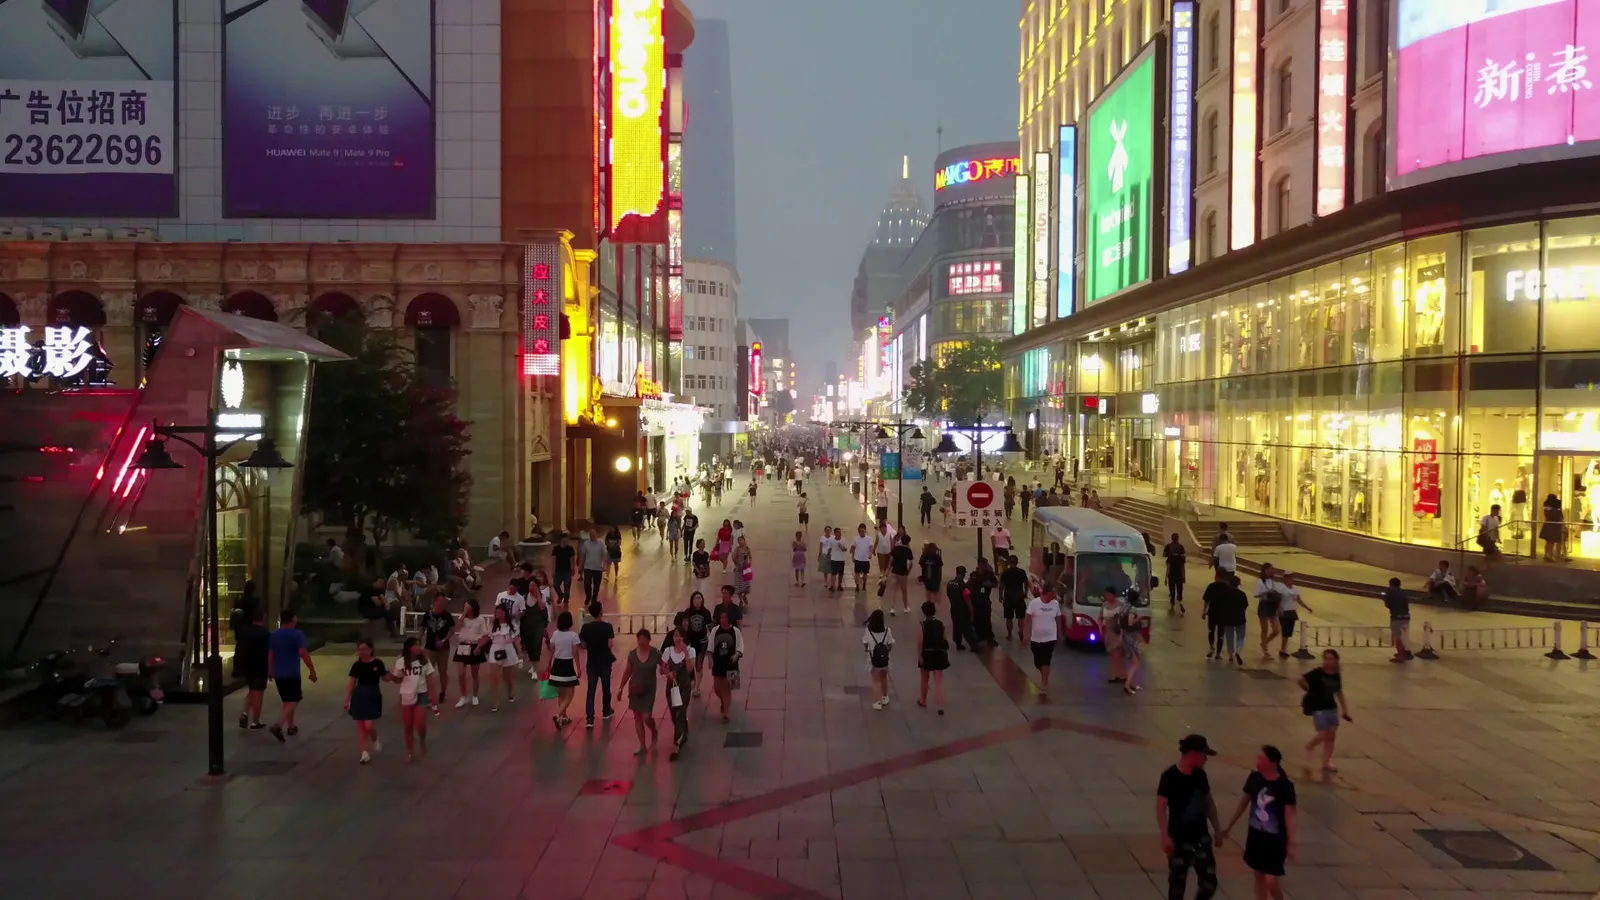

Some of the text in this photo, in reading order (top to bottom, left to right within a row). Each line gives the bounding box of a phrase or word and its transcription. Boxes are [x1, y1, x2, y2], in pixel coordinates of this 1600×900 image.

[0, 89, 147, 125] 广告位招商
[267, 105, 389, 121] 进步 再进一步
[268, 124, 389, 135] 革命性的安卓体验
[4, 134, 162, 165] 23622696
[266, 149, 390, 158] HUAWEI Mate 9 Mate 9 Pro
[0, 325, 94, 378] 摄影
[958, 509, 1003, 518] 一切车辆
[958, 518, 1003, 527] 禁止驶入
